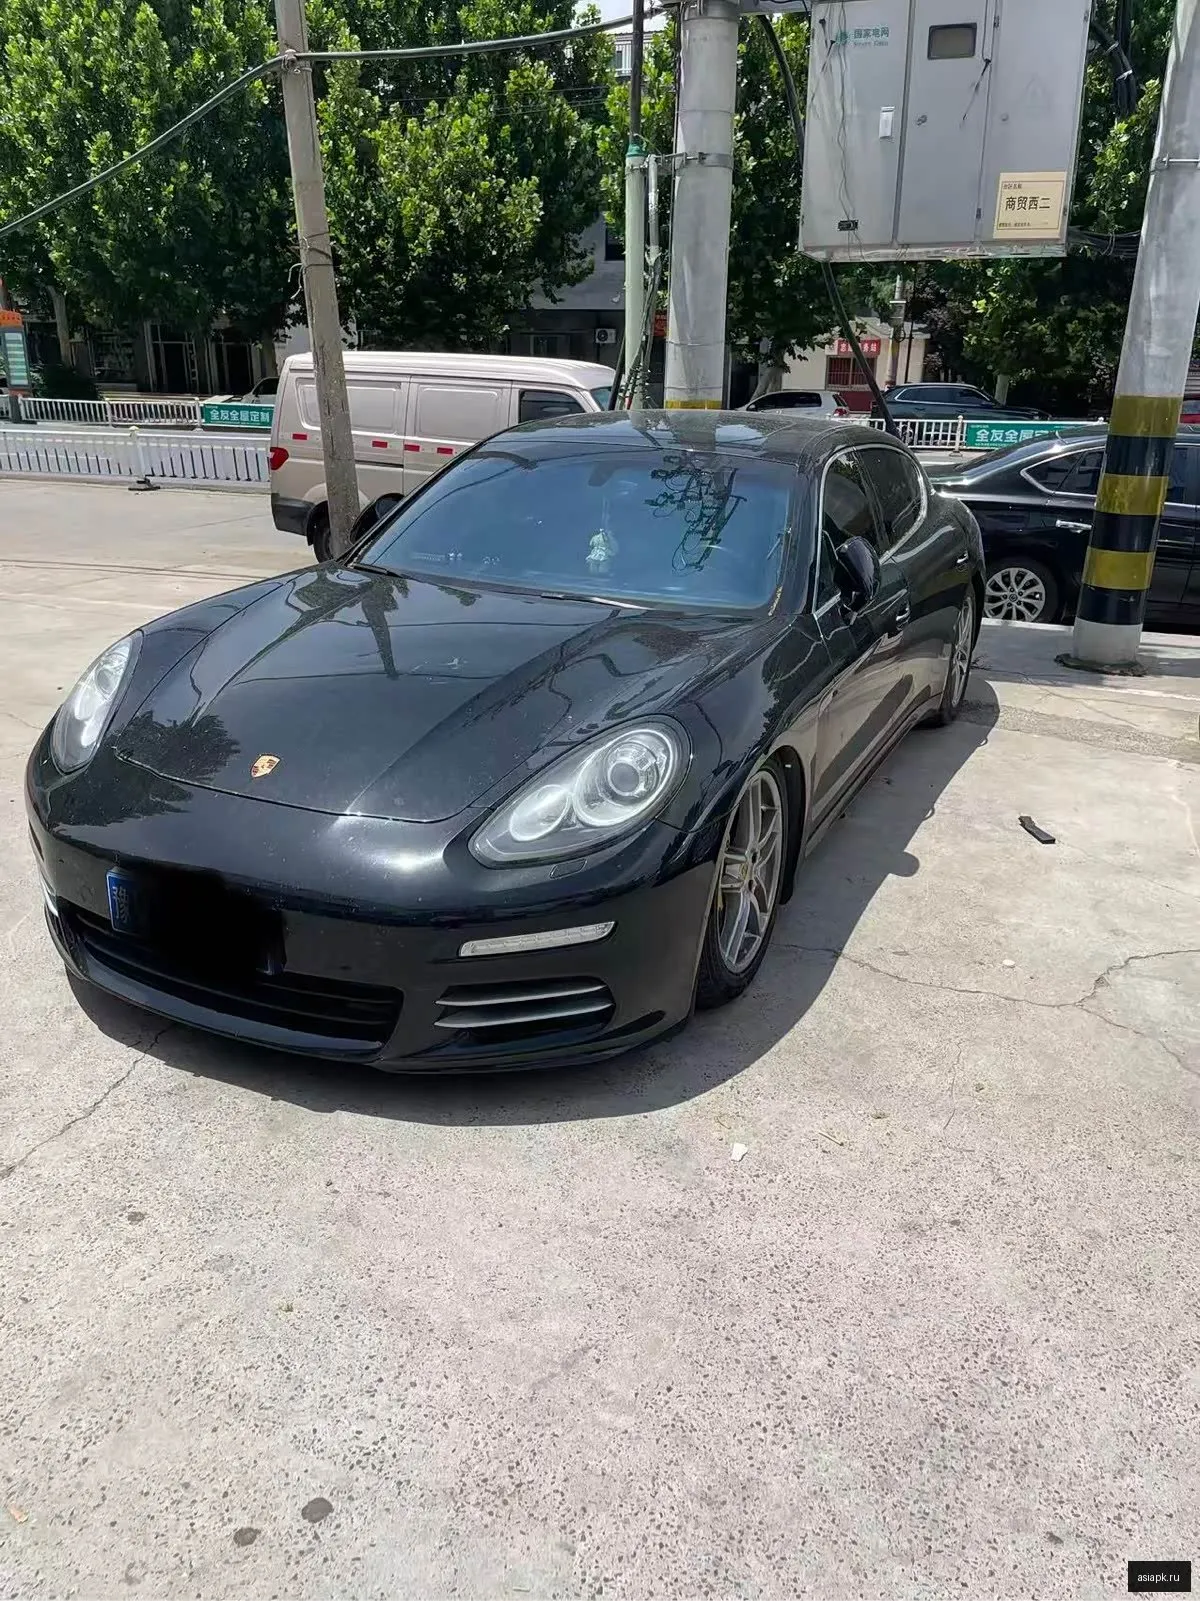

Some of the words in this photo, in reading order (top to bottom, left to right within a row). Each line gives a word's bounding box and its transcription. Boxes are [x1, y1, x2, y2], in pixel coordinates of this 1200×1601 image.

[854, 27, 889, 39] 国家电网
[1005, 196, 1050, 211] 商贸西二
[210, 409, 270, 422] 全友全屋定制
[975, 429, 1050, 443] 全友全屋
